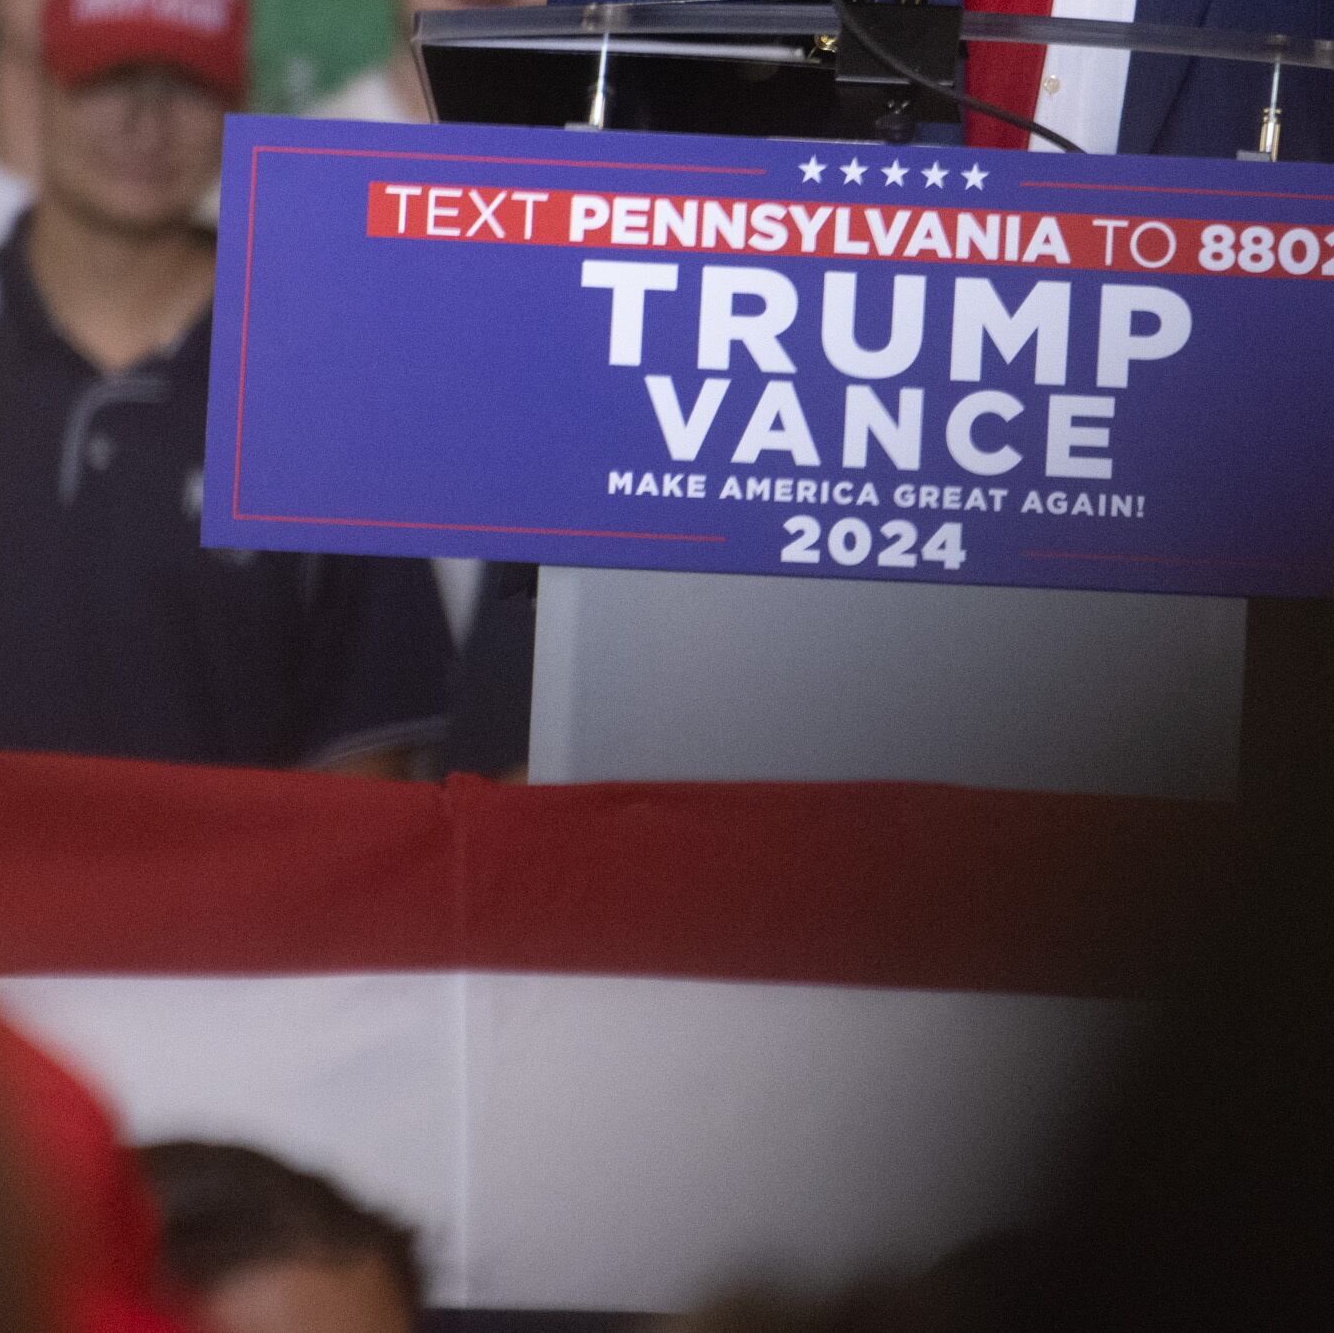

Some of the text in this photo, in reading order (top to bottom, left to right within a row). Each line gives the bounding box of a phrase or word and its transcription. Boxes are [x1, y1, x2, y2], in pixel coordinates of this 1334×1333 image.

[384, 184, 550, 241] TEXT
[568, 193, 1072, 265] PENNSYLVANIA
[1091, 218, 1177, 269] TO
[580, 258, 1193, 389] TRUMP
[643, 373, 1116, 480] VANCE
[607, 469, 1145, 519] MAKE AMERICA GREAT AGAIN!
[781, 514, 966, 569] 2024
